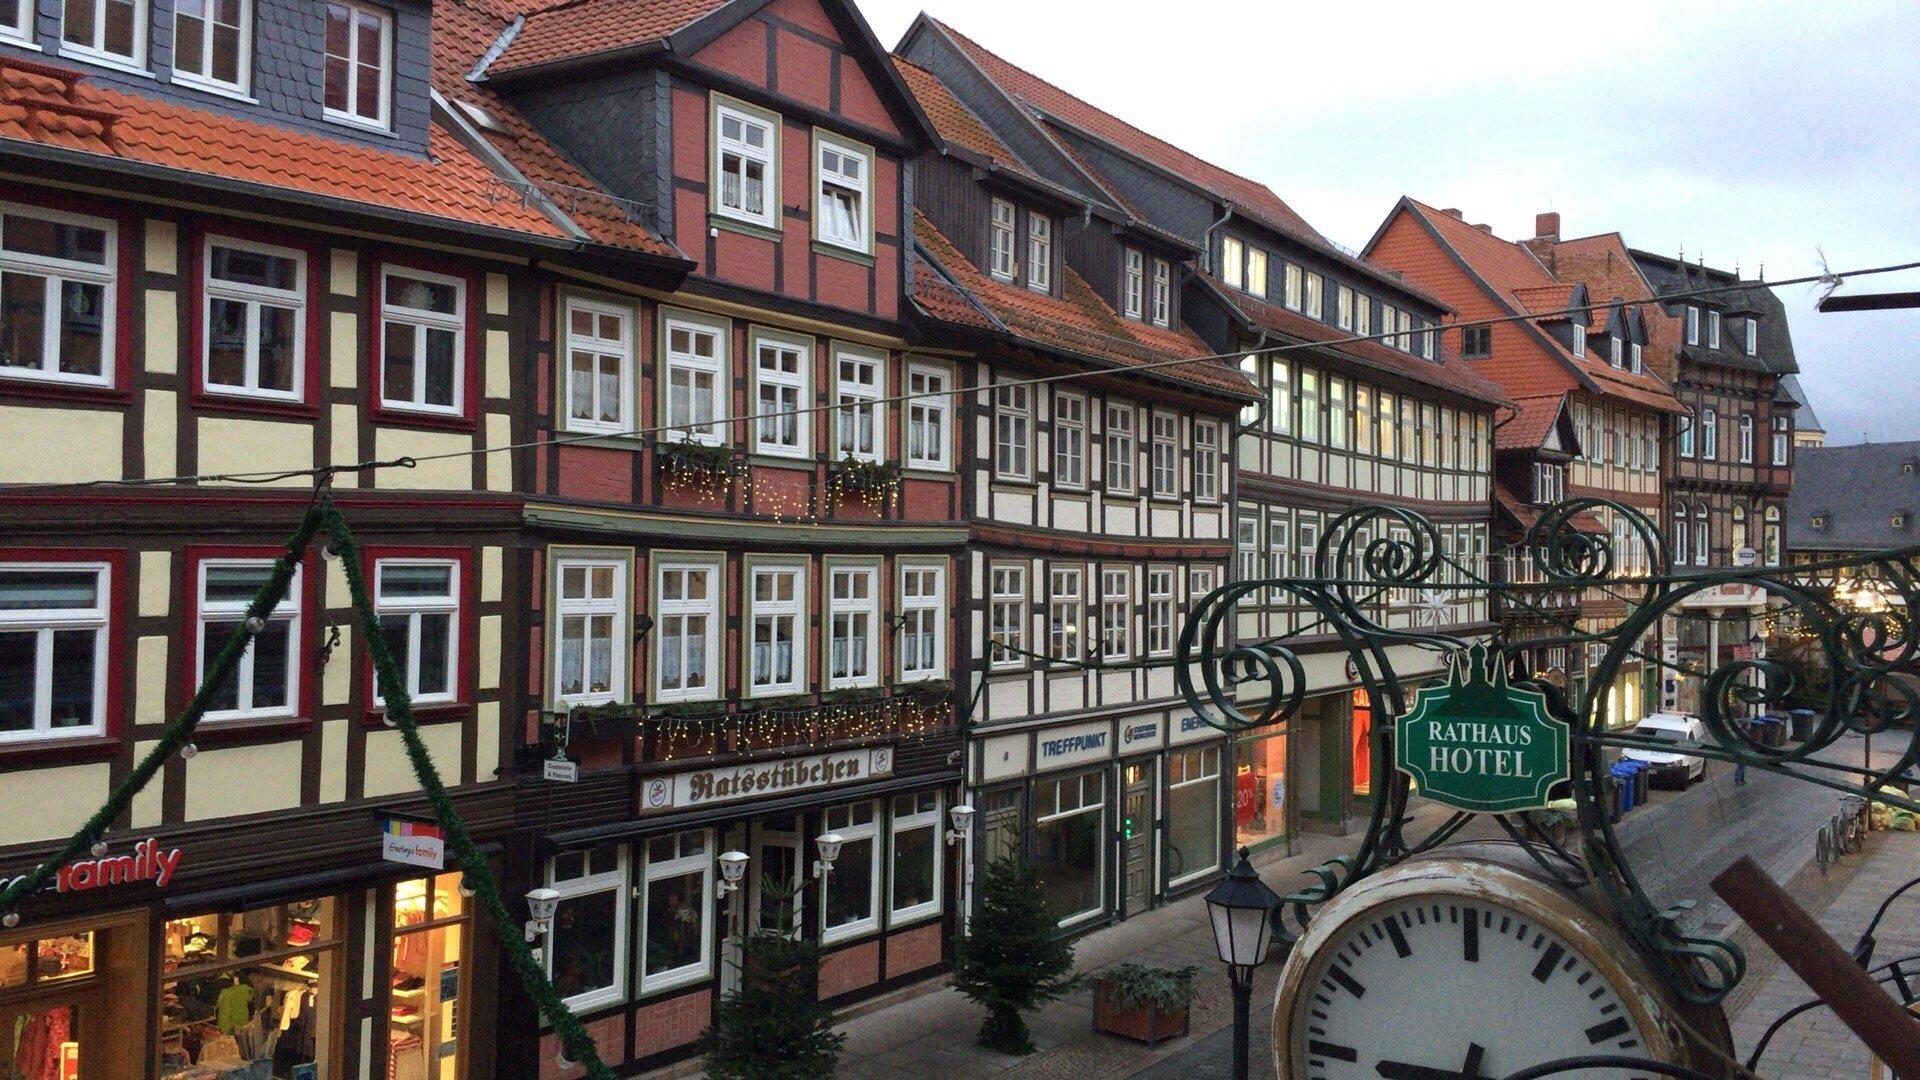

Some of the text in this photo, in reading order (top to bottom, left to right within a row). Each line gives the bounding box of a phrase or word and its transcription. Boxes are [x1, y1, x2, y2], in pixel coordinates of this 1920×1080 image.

[1042, 731, 1107, 757] TREFFPUNKT
[1428, 721, 1532, 746] RATHAUS
[1429, 745, 1533, 778] HOTEL
[689, 755, 860, 802] Ratsstübchen
[415, 844, 438, 861] family
